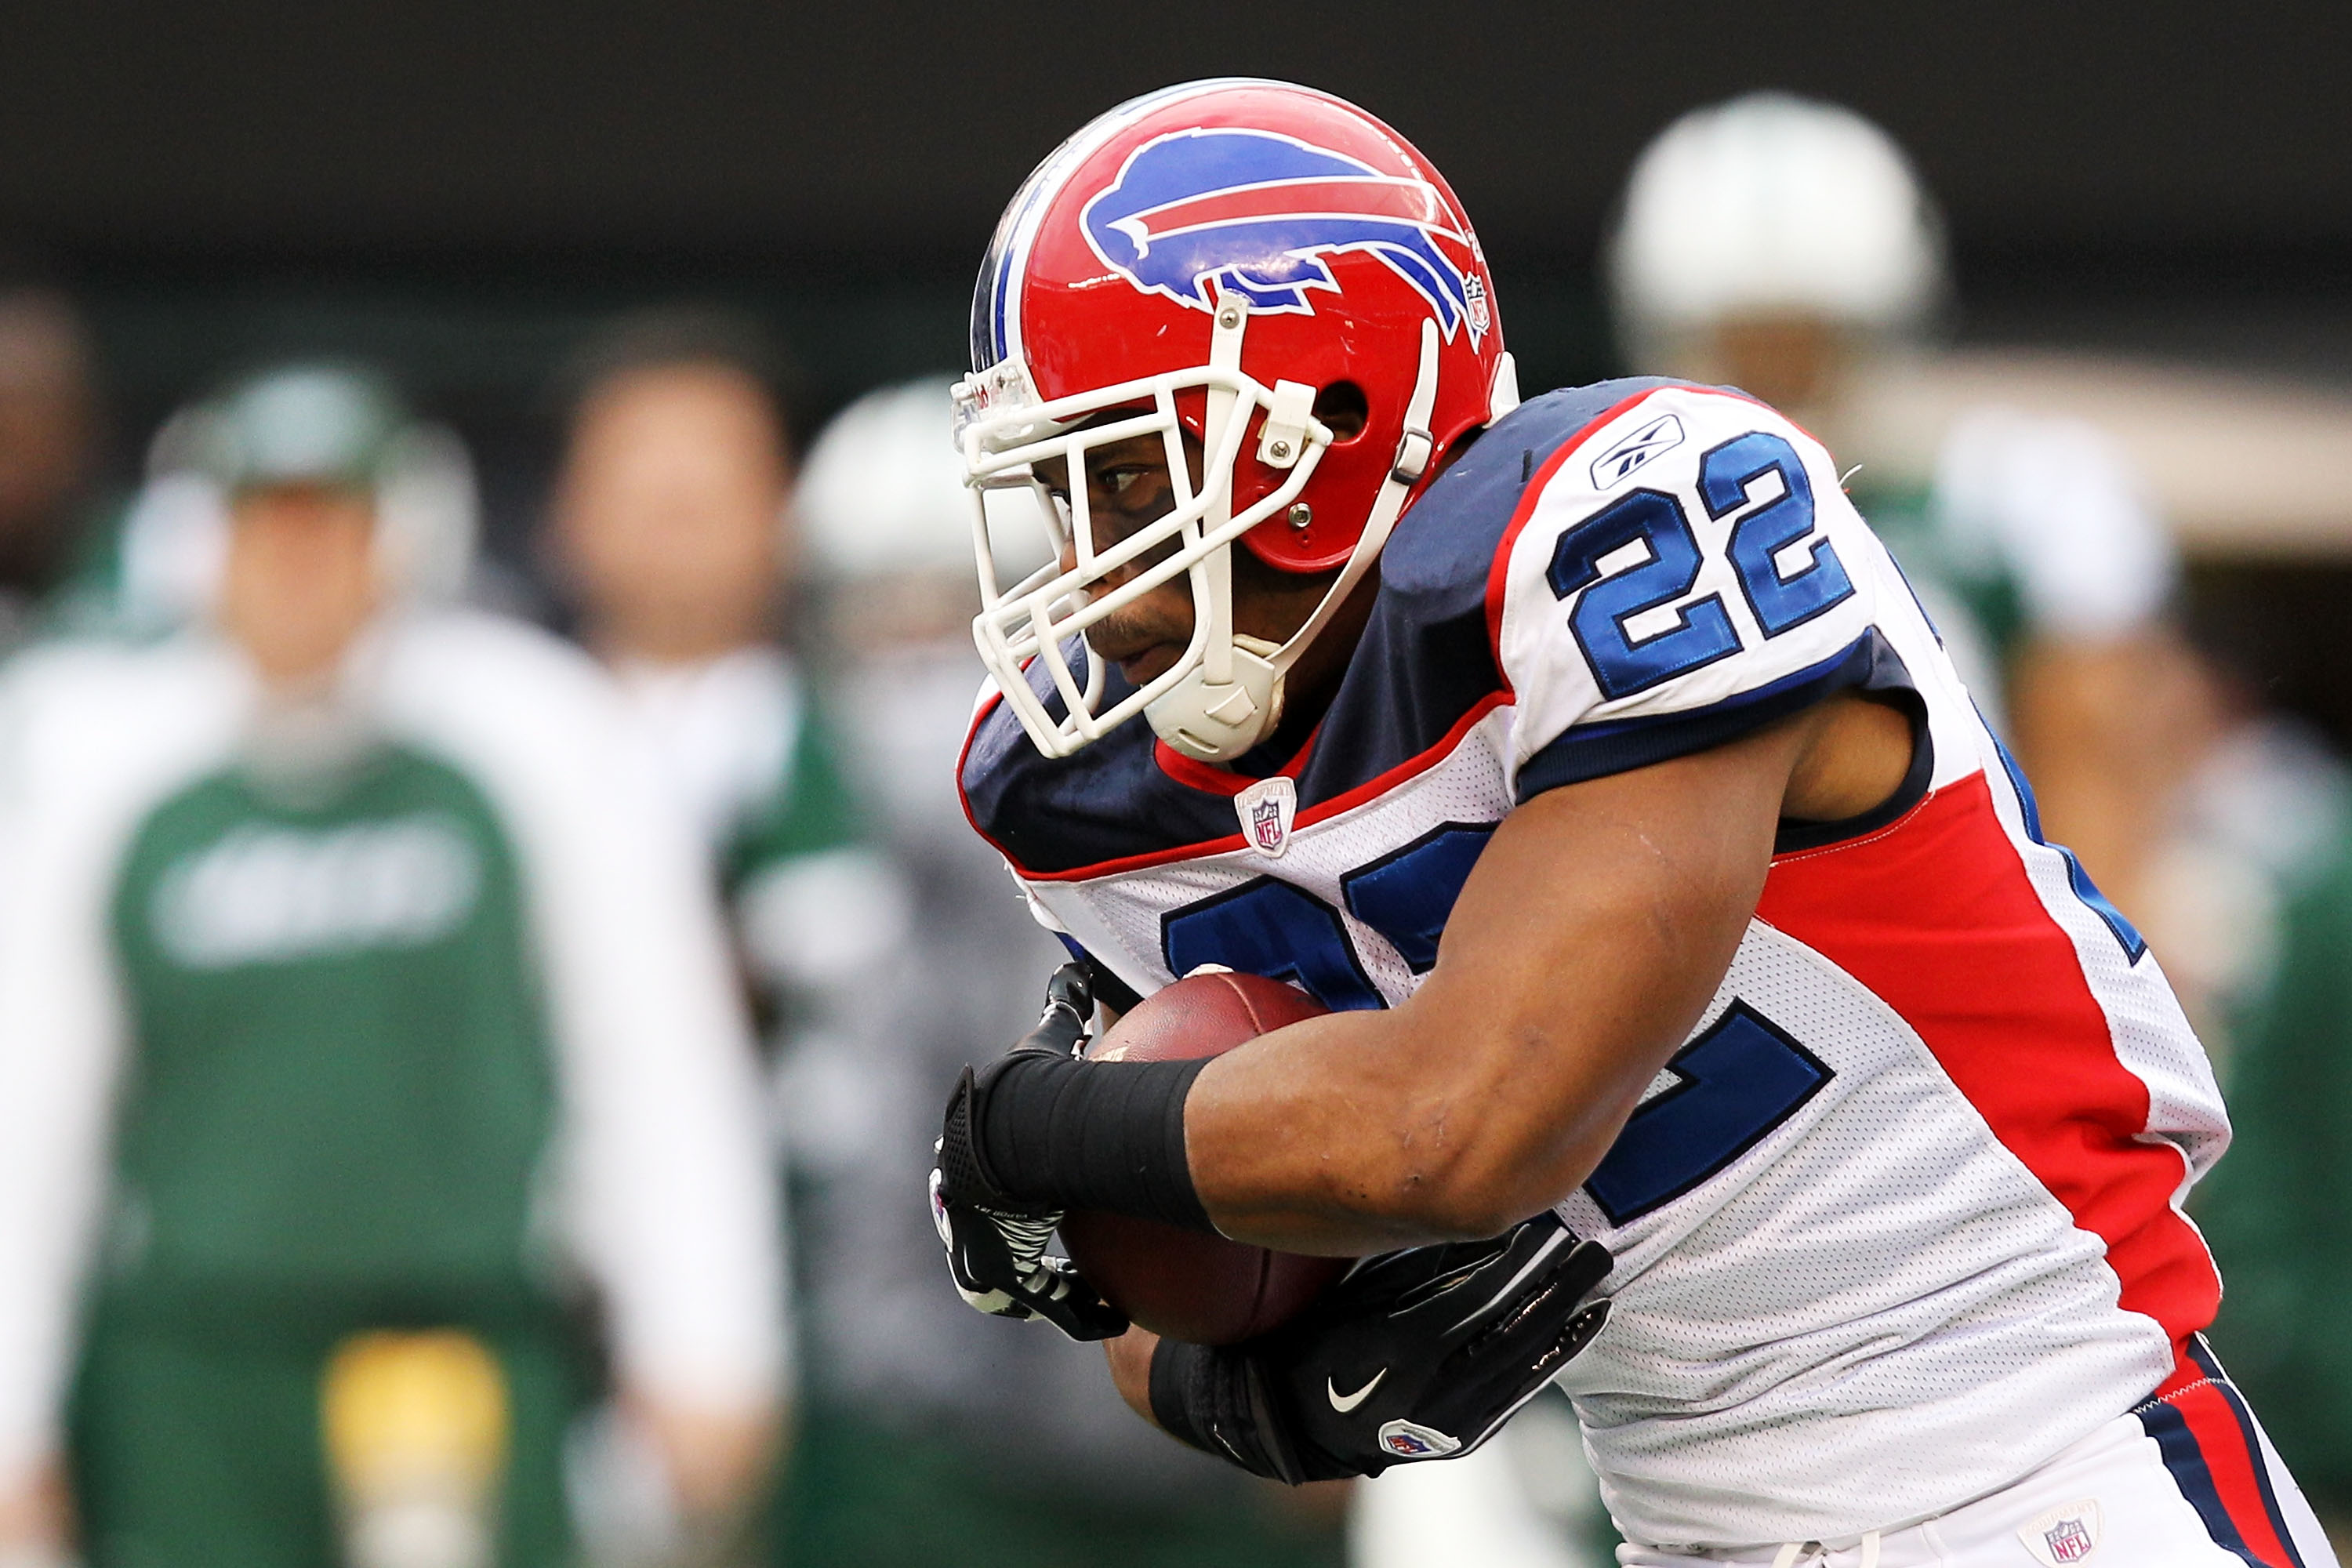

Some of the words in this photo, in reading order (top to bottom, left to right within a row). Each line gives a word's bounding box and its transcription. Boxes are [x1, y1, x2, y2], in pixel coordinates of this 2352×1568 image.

[1545, 430, 1857, 701] 22
[1255, 818, 1283, 846] NFL
[2053, 1534, 2091, 1560] NFL
